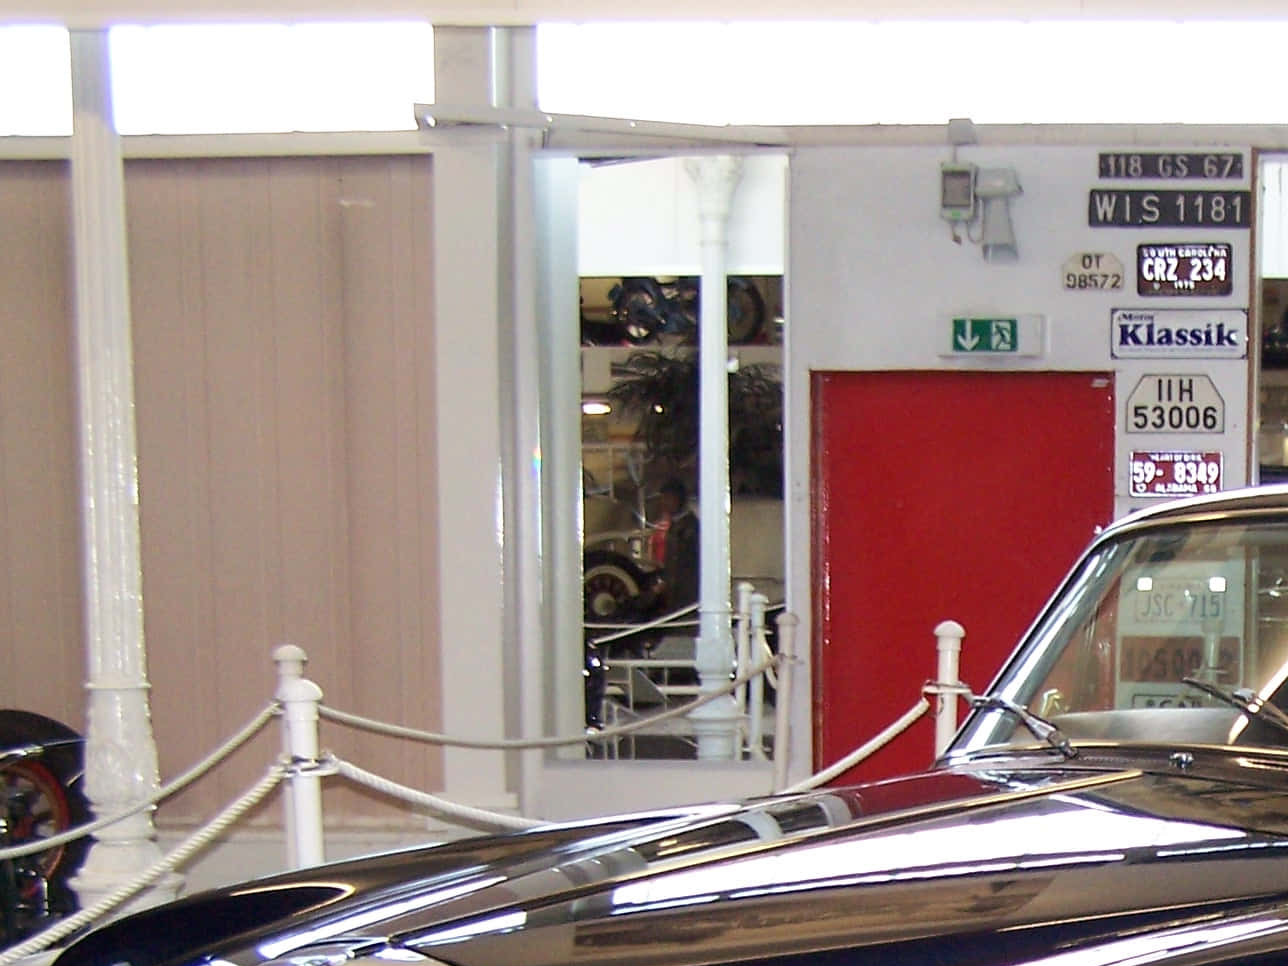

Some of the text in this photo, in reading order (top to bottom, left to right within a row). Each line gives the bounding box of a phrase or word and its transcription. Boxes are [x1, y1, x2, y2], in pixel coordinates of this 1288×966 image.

[1108, 156, 1234, 177] 118 GS 67
[1095, 194, 1241, 222] WIS 1181
[1066, 273, 1121, 289] 98572
[1142, 258, 1226, 281] CRZ 234
[1118, 323, 1239, 346] Klassik
[1133, 406, 1217, 430] 53006
[1174, 462, 1219, 484] 8349
[1142, 594, 1221, 617] JSC 715
